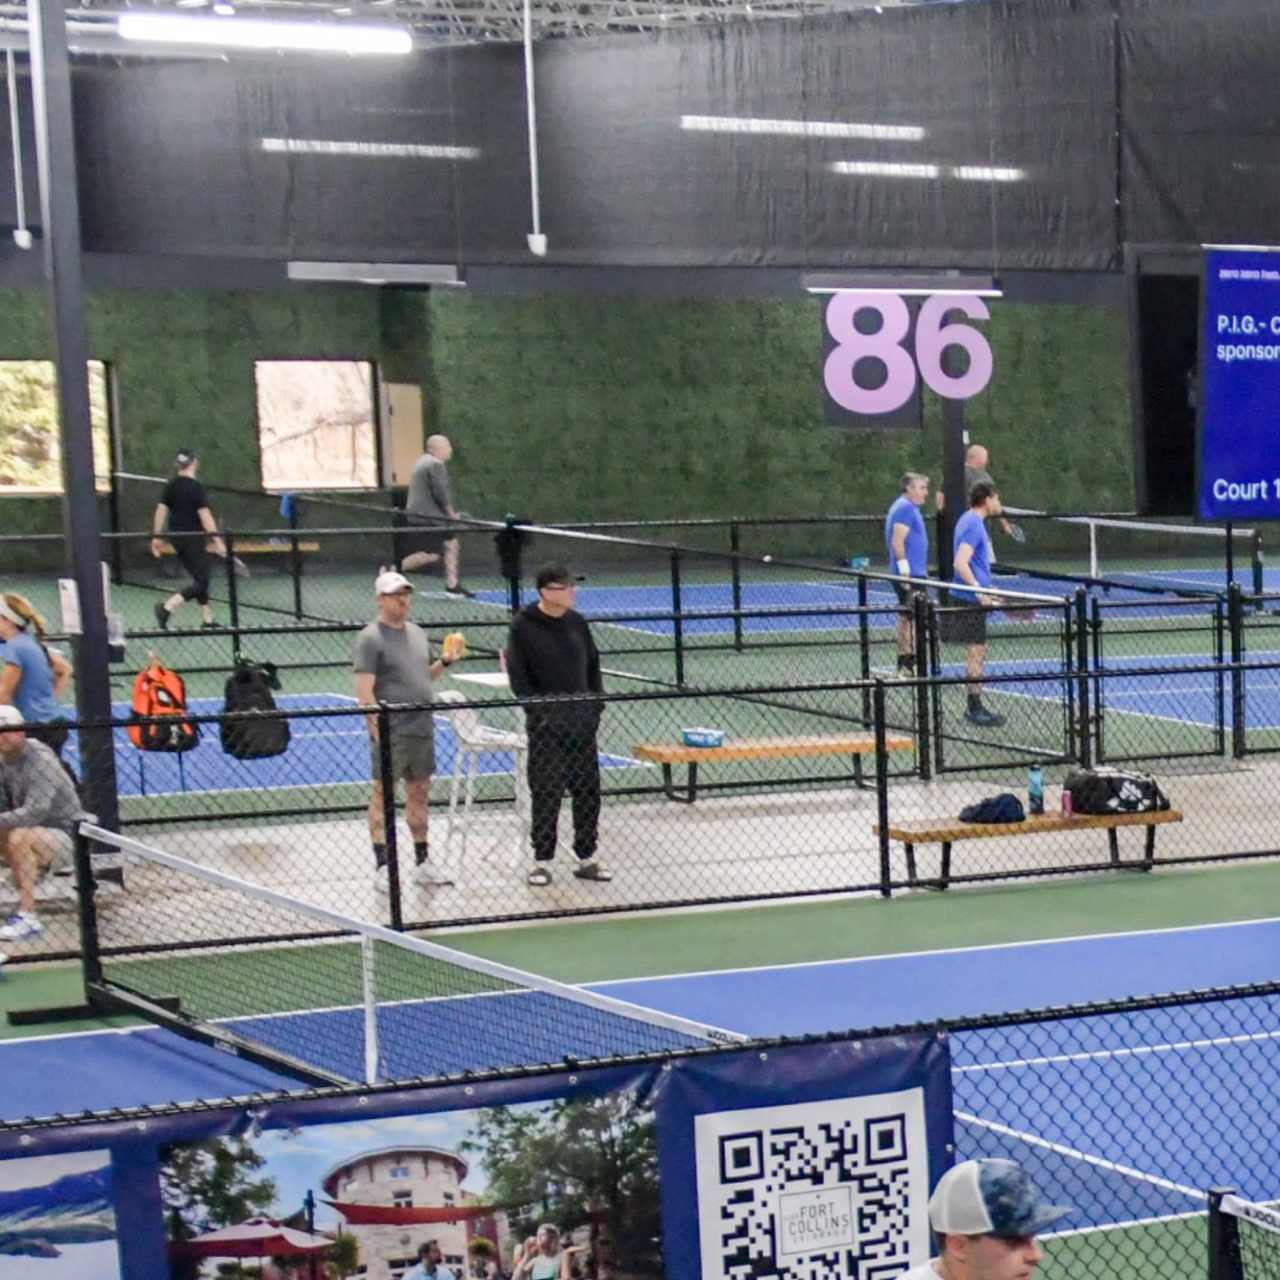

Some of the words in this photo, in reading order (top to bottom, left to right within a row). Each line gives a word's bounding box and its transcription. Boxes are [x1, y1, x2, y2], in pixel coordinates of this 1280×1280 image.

[824, 292, 916, 413] 8
[917, 294, 993, 399] 6
[1212, 477, 1269, 501] Court
[800, 1201, 835, 1219] FORT
[788, 1213, 850, 1236] COLLINS
